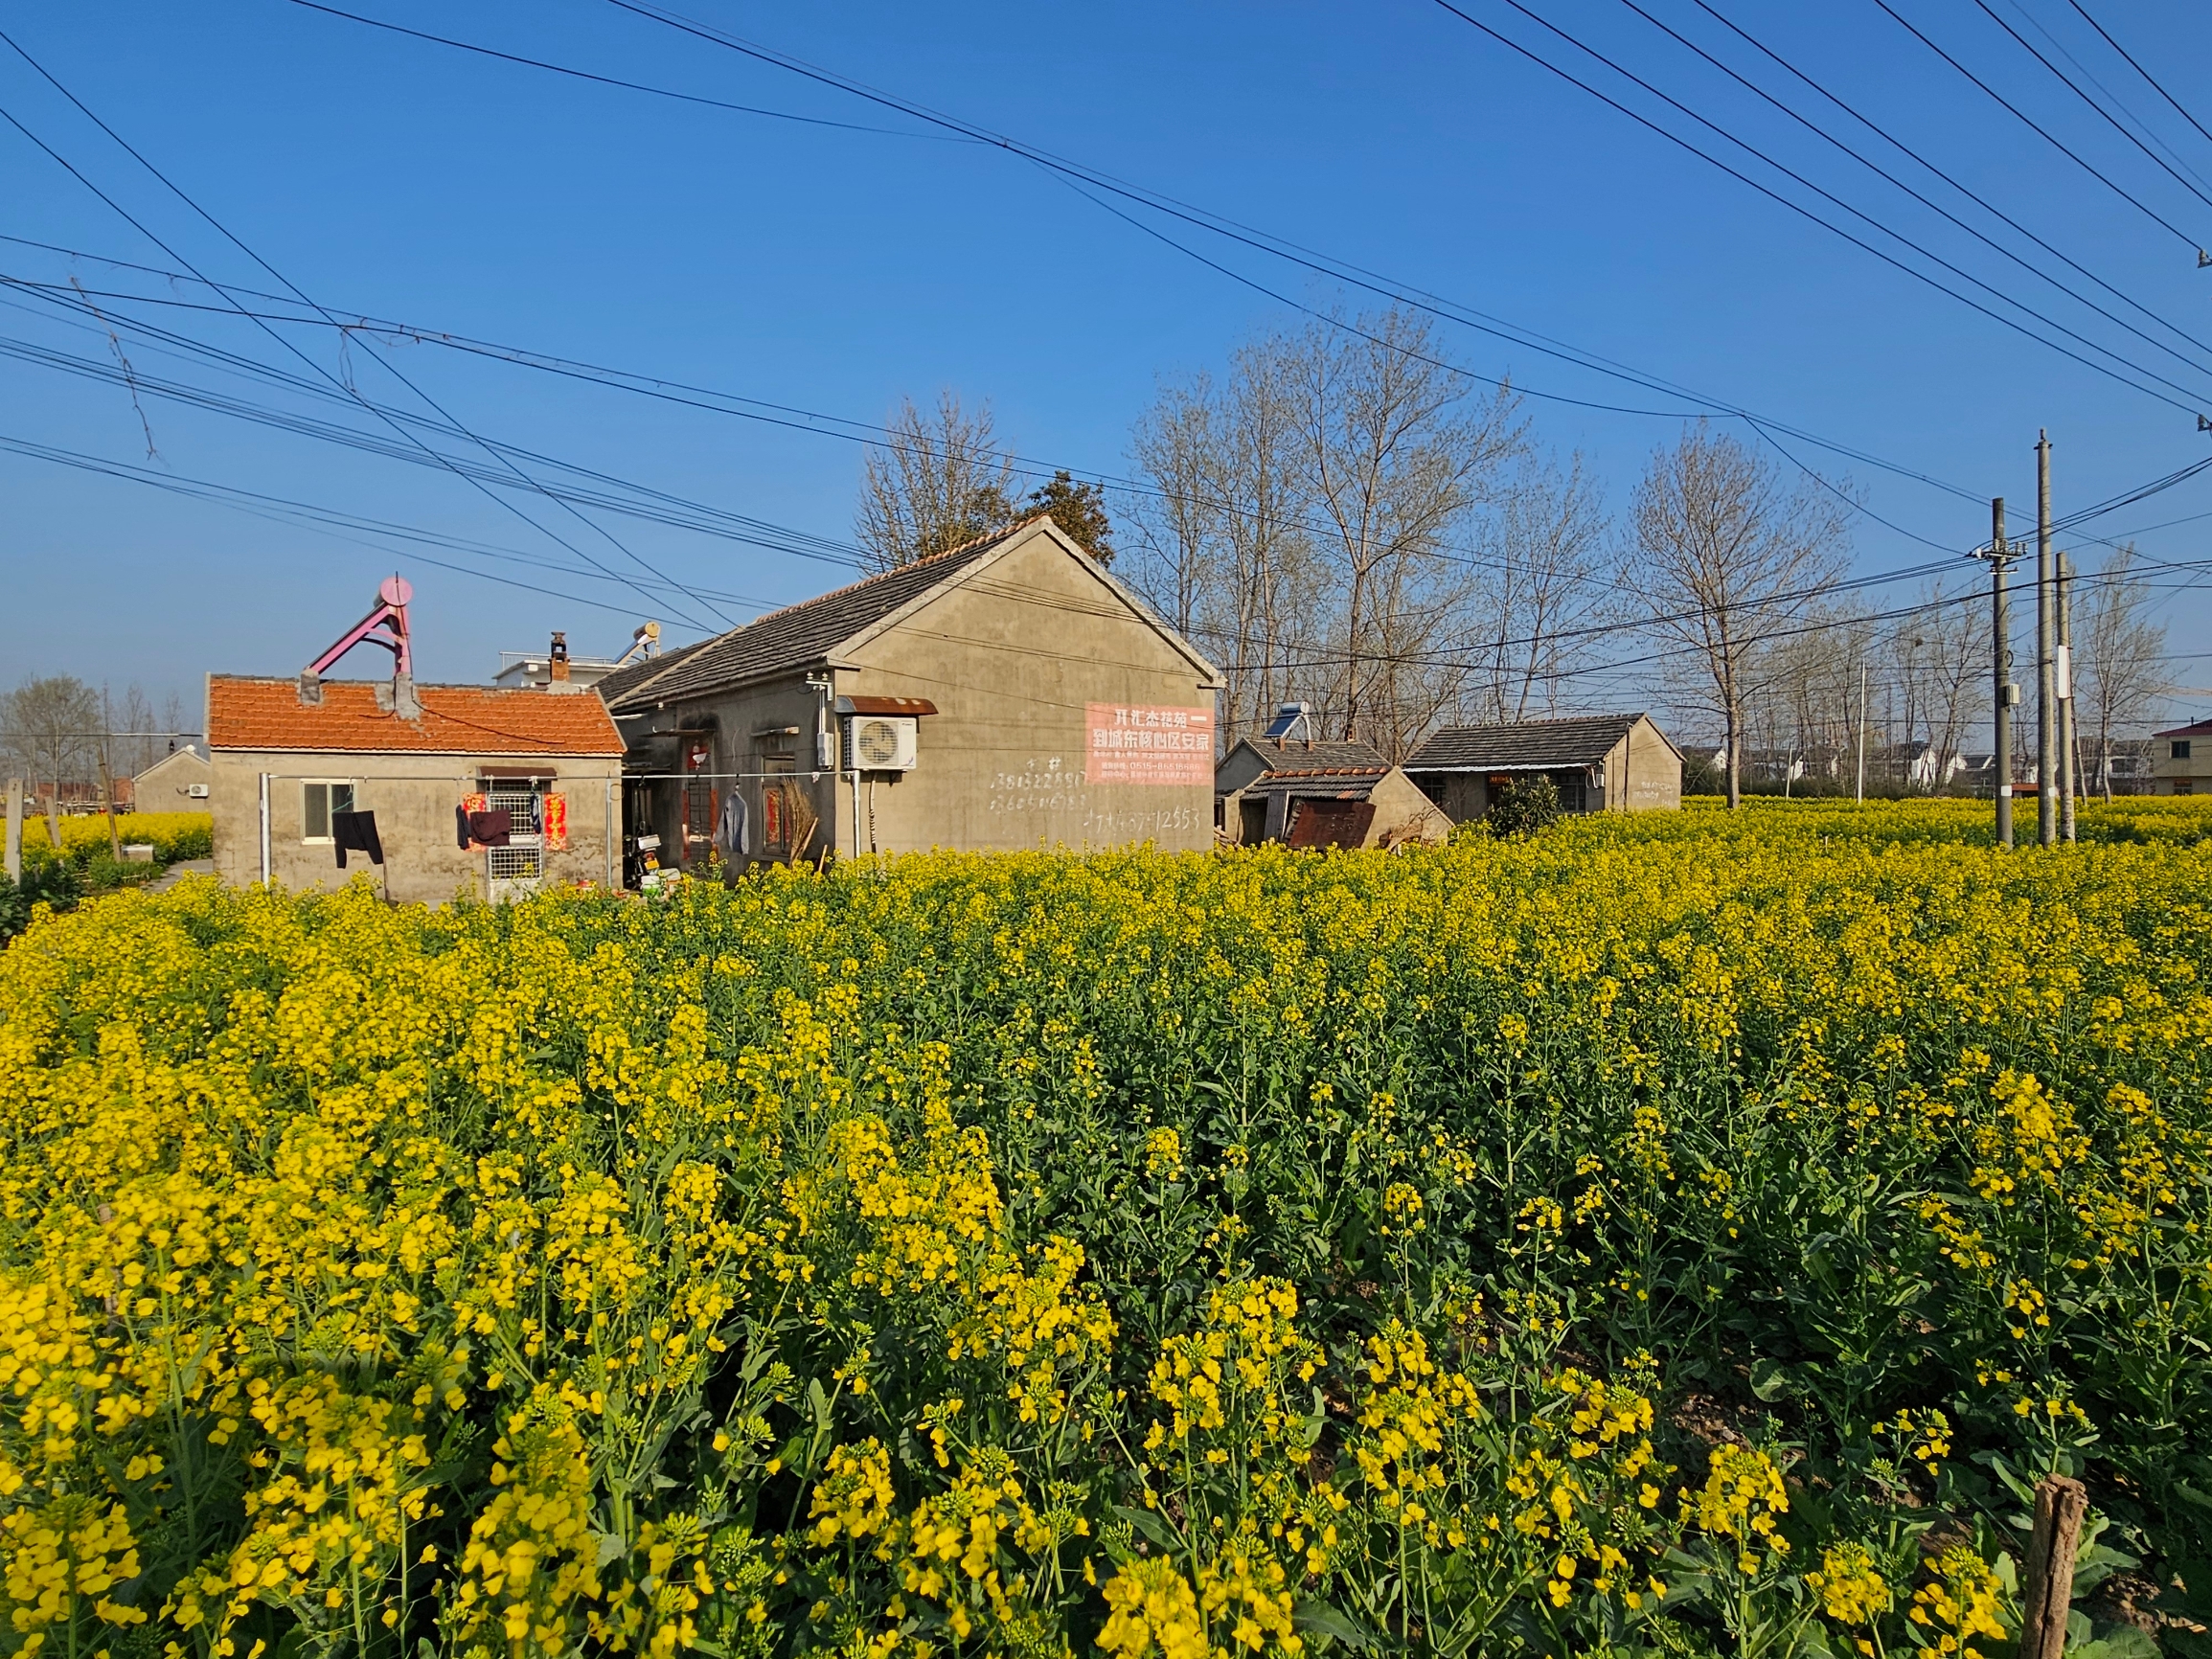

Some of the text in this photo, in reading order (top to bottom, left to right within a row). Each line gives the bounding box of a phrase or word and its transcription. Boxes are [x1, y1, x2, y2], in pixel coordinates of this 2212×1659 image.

[1092, 728, 1209, 750] 到城东核心区安家
